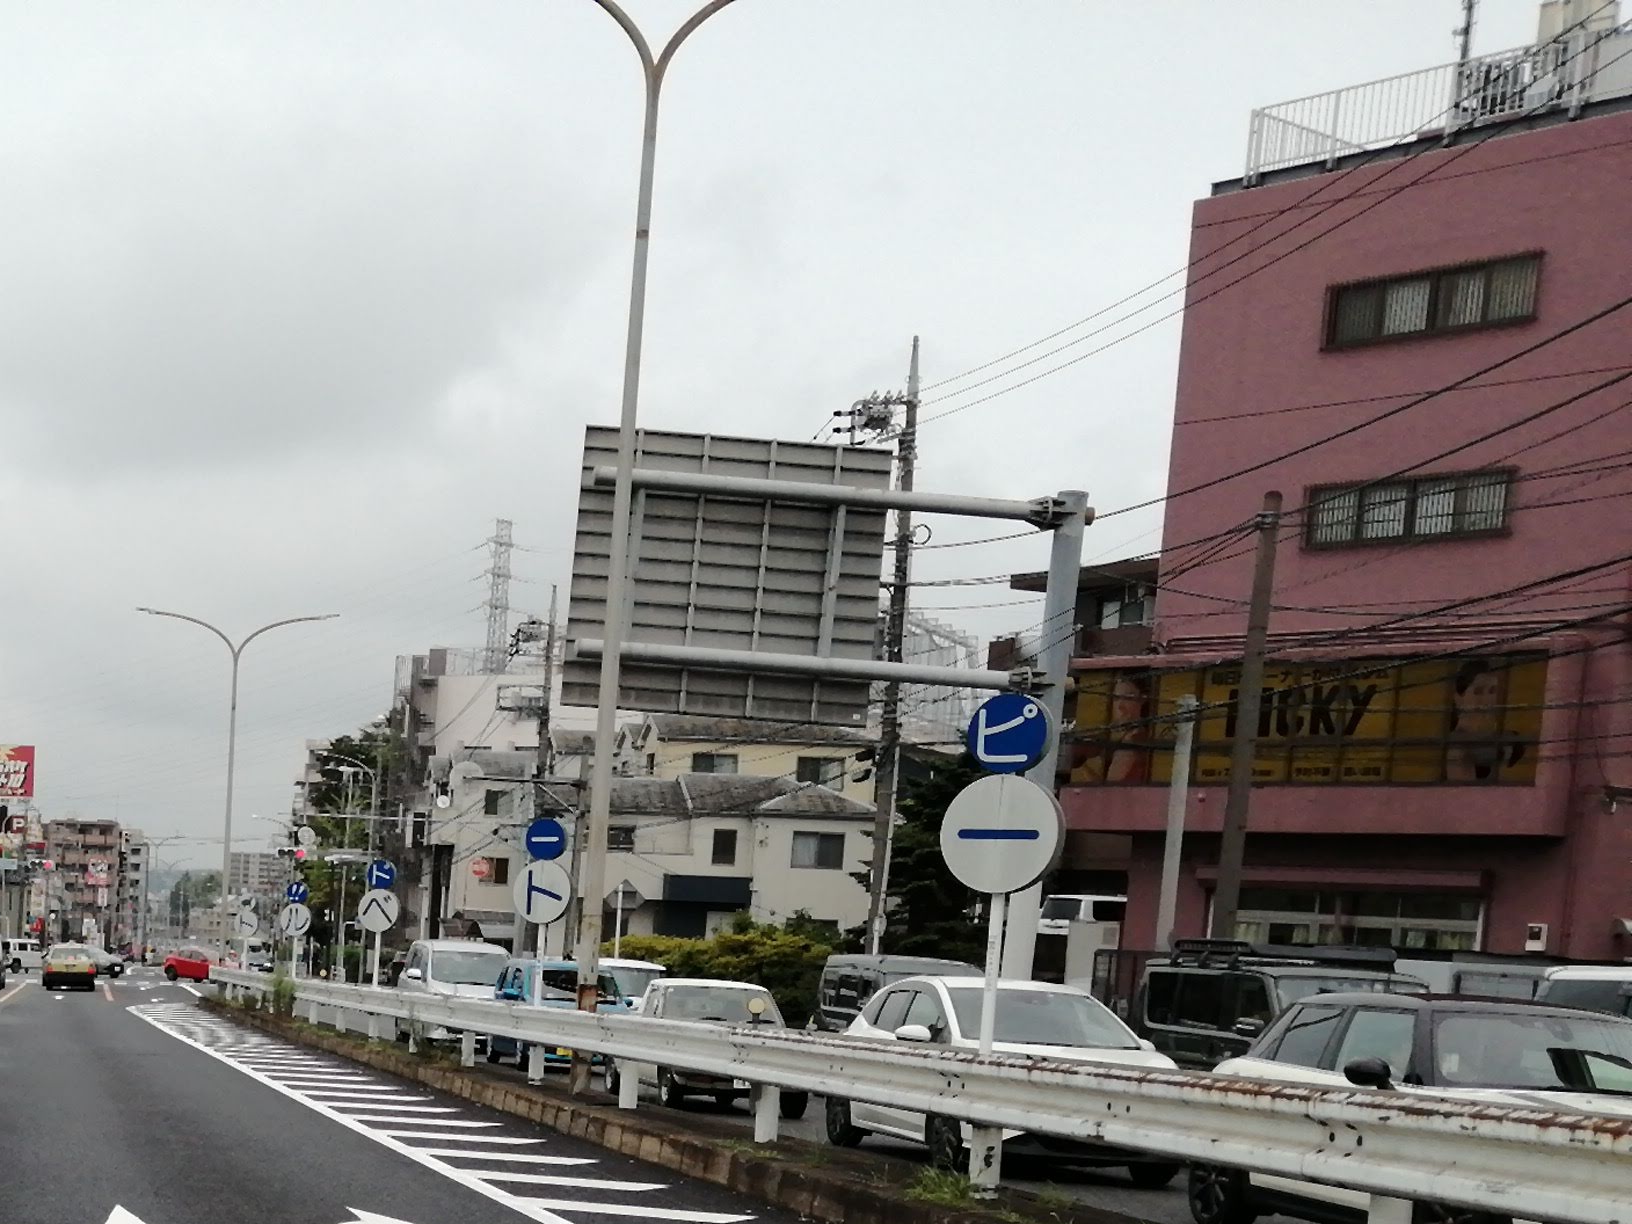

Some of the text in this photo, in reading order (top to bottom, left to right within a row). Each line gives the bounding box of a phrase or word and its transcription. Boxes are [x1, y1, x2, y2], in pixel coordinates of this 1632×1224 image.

[977, 703, 1039, 763] ピ
[13, 818, 25, 830] P
[371, 862, 392, 886] ド
[526, 869, 563, 916] ト
[284, 908, 310, 931] ル
